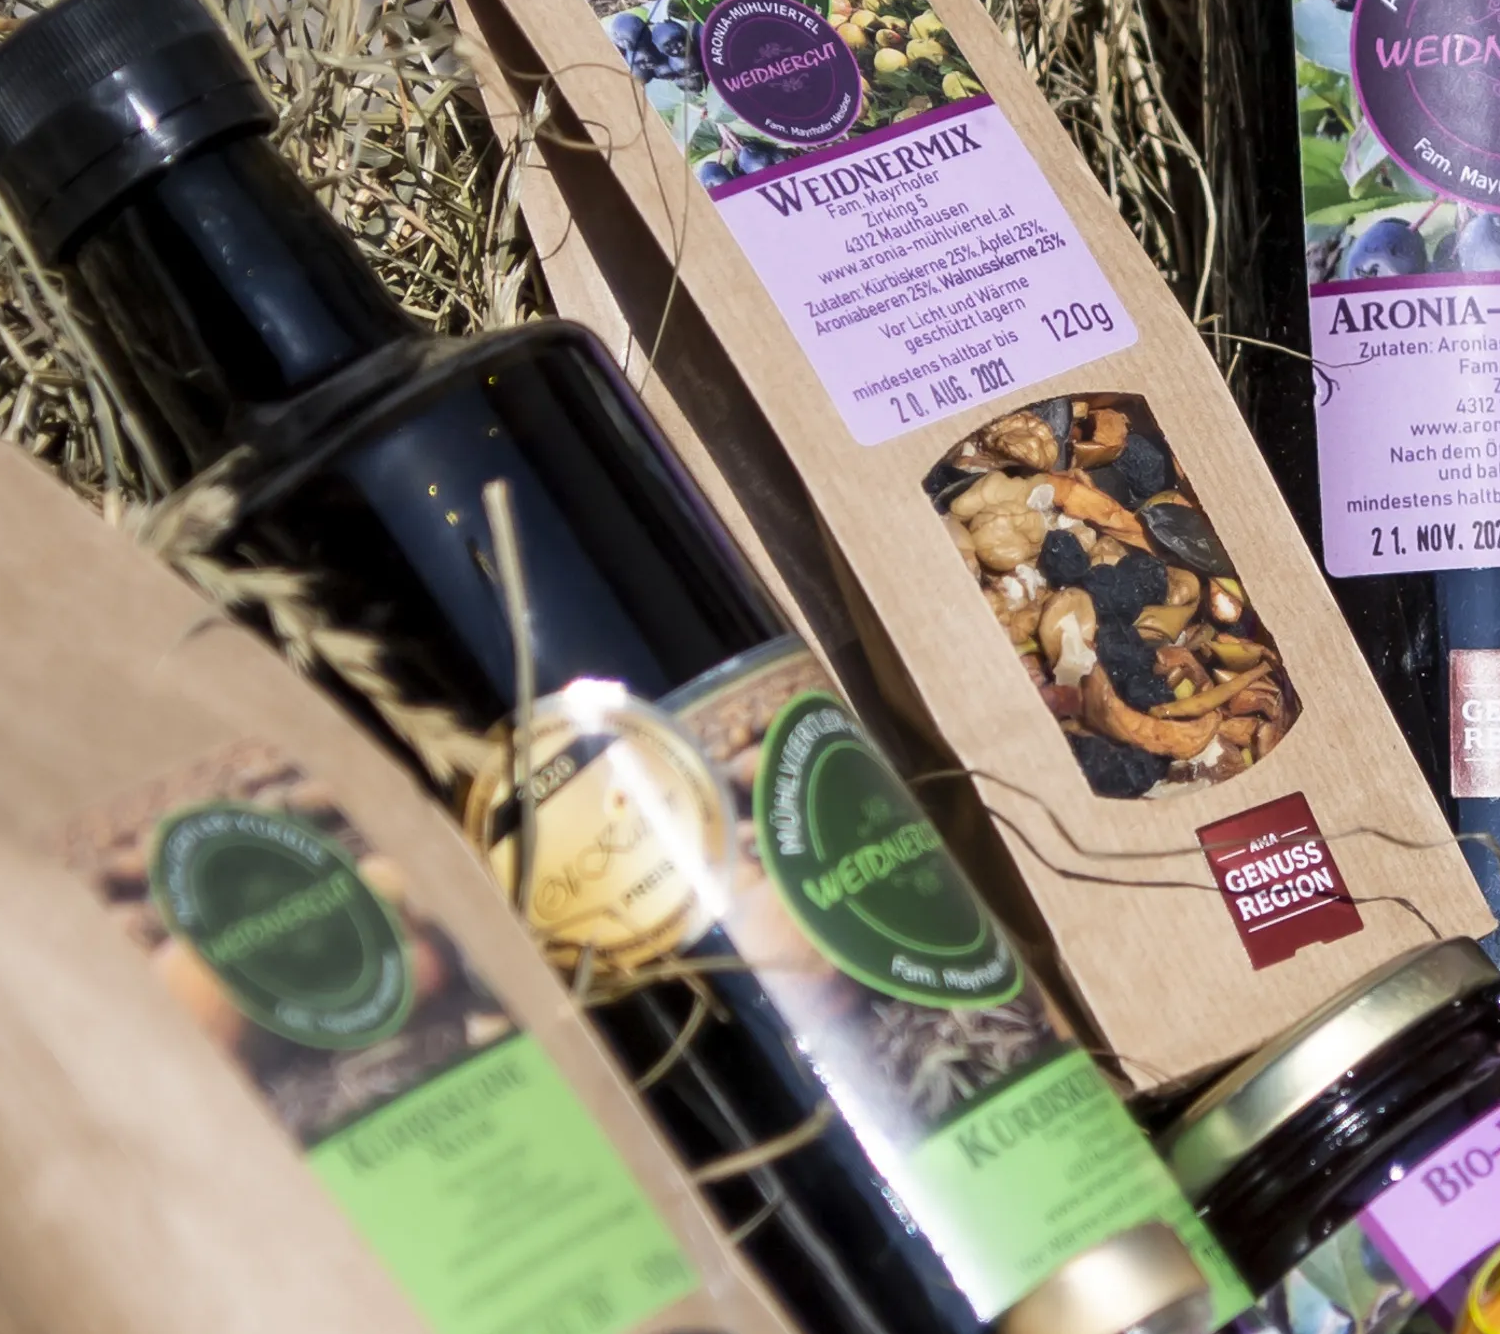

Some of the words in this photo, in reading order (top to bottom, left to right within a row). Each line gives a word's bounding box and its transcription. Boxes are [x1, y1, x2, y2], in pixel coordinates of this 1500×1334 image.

[711, 1, 820, 65] ARONIA-MÜHLVIERTEL
[723, 42, 836, 92] WEIDNERGUT
[756, 123, 982, 217] WEIDNERMIX
[826, 202, 866, 219] Fam.
[864, 170, 940, 206] Mayrhofer
[845, 232, 878, 253] 4312
[879, 202, 969, 242] Mauthausen
[862, 200, 918, 228] Zirking
[916, 193, 928, 208] 5
[818, 203, 1015, 285] www.aronia-mühlviertel.at
[804, 287, 864, 318] Zutaten:
[861, 256, 948, 298] Kürbiskerne
[979, 231, 1015, 259] Äpfel
[815, 292, 909, 336] Aroniabeeren
[937, 244, 1038, 290] Walnusskerne
[1036, 232, 1066, 254] 25%
[878, 322, 907, 340] Vor
[907, 306, 947, 329] Licht
[945, 294, 976, 315] und
[975, 276, 1030, 304] Wärme
[904, 316, 978, 354] geschützt
[976, 297, 1026, 323] lagern
[1041, 302, 1114, 343] 120g
[852, 356, 942, 402] mindestens
[941, 340, 992, 369] haltbar
[995, 329, 1019, 350] bis
[1359, 341, 1433, 358] Zutaten:
[1459, 359, 1500, 373] Fam.
[933, 375, 972, 409] AUG.
[972, 357, 1016, 395] 2021
[1456, 398, 1495, 413] 4312
[1391, 446, 1436, 463] Nach
[1442, 444, 1481, 459] dem
[1439, 465, 1471, 481] und
[1347, 489, 1452, 513] mindestens
[1418, 522, 1463, 551] NOV.
[517, 755, 576, 799] 020
[1225, 841, 1322, 892] GENUSS
[1250, 833, 1279, 852] AMA
[1236, 867, 1334, 922] REGION
